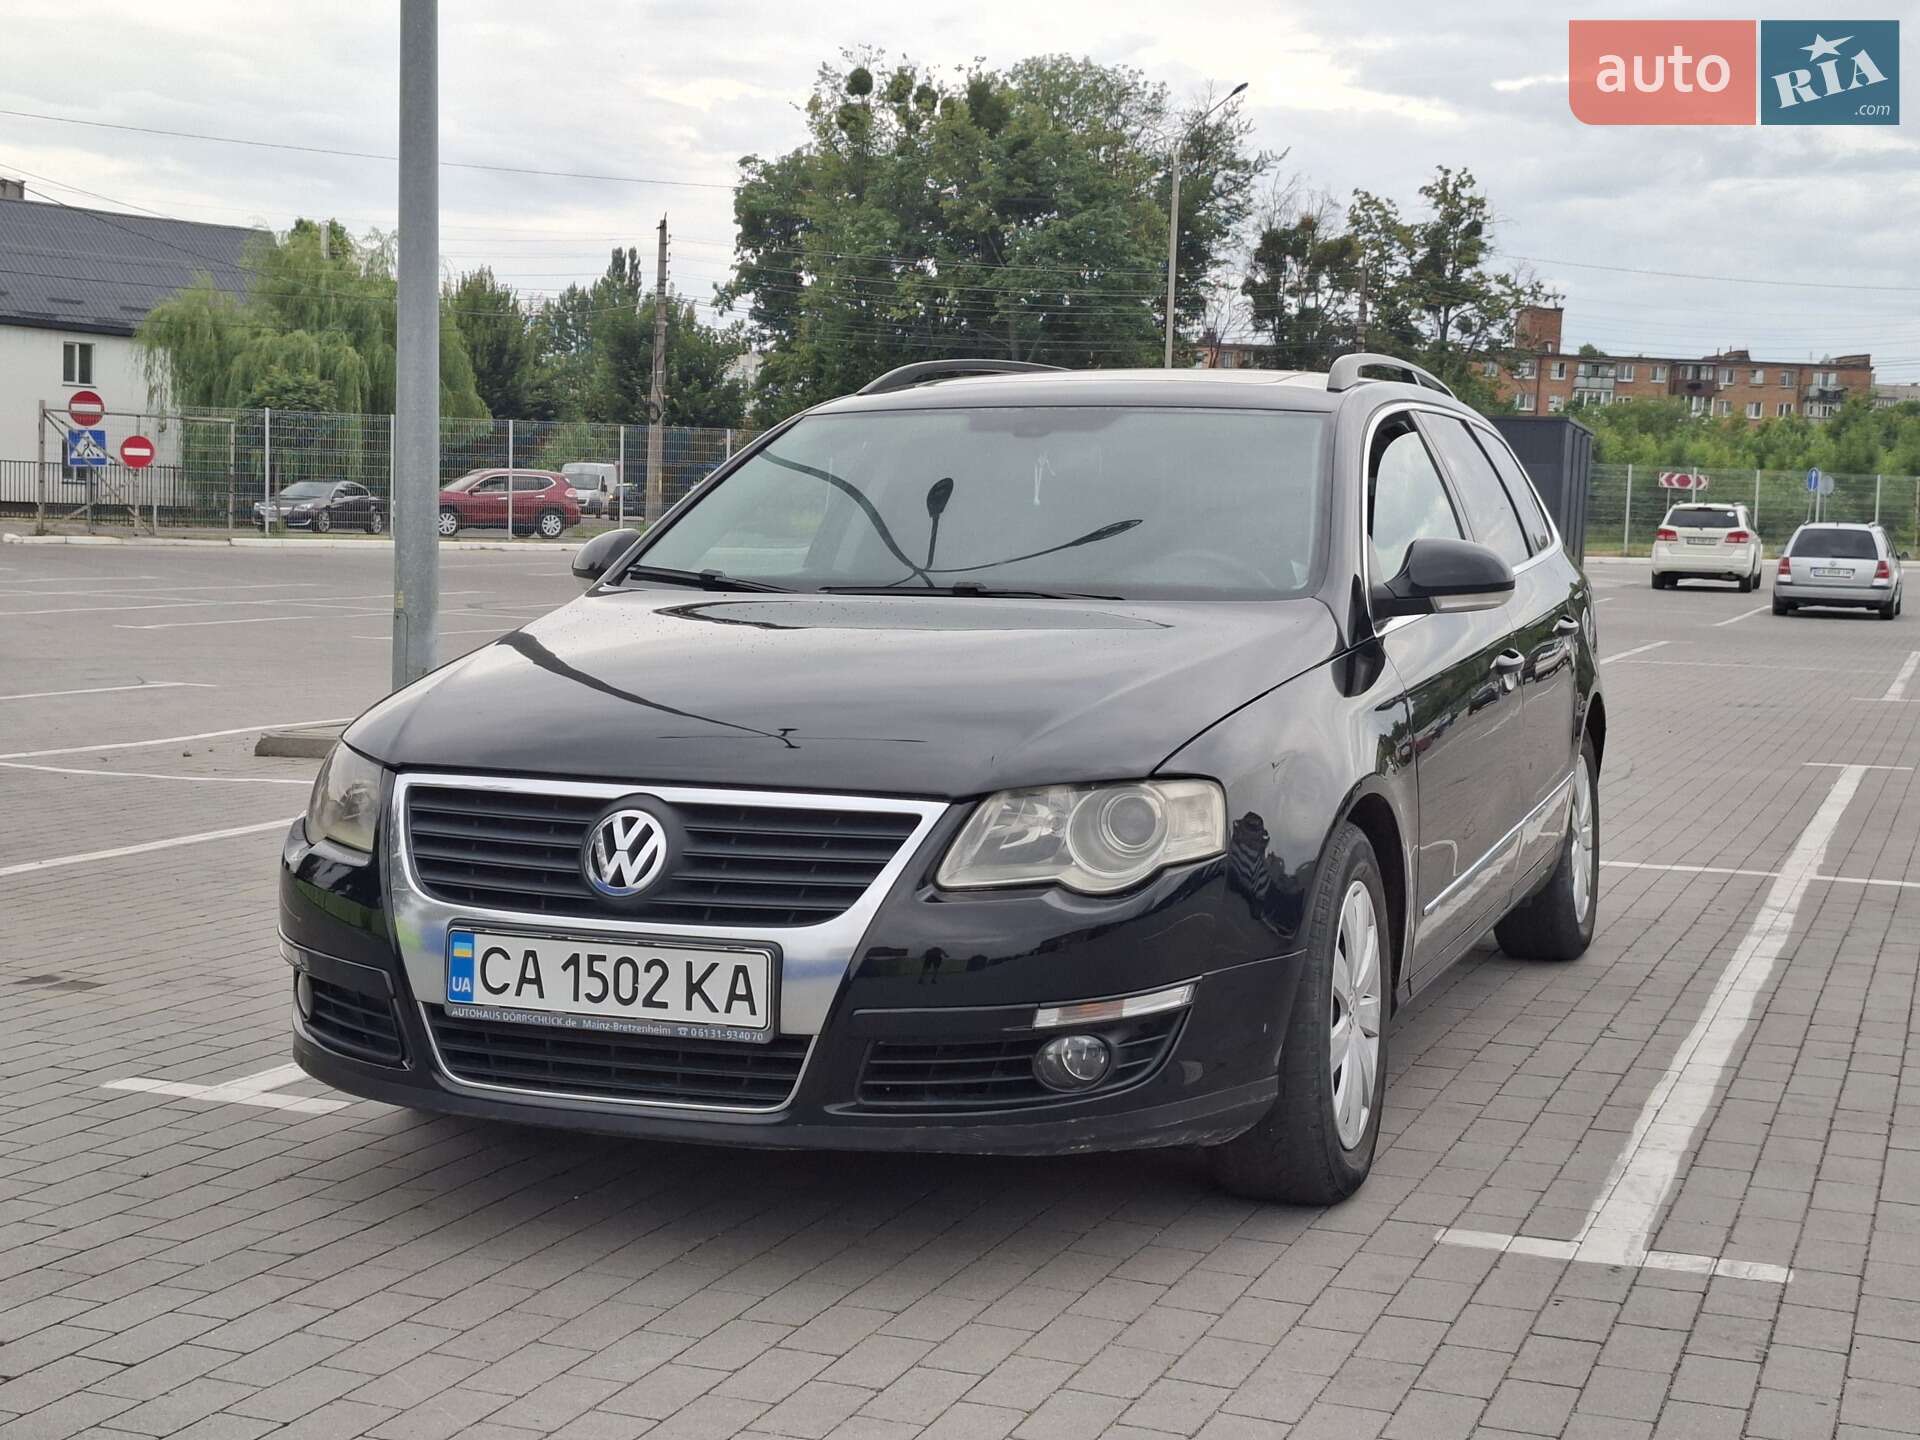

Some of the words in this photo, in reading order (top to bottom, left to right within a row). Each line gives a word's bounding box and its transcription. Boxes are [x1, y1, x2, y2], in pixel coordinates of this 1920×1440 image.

[452, 976, 472, 993] UA
[479, 946, 545, 999] CA
[561, 952, 670, 1009] 1502
[685, 960, 757, 1016] KA
[451, 1007, 501, 1021] AUTOHAUS
[582, 1019, 671, 1036] Mainz-Bretzenheim
